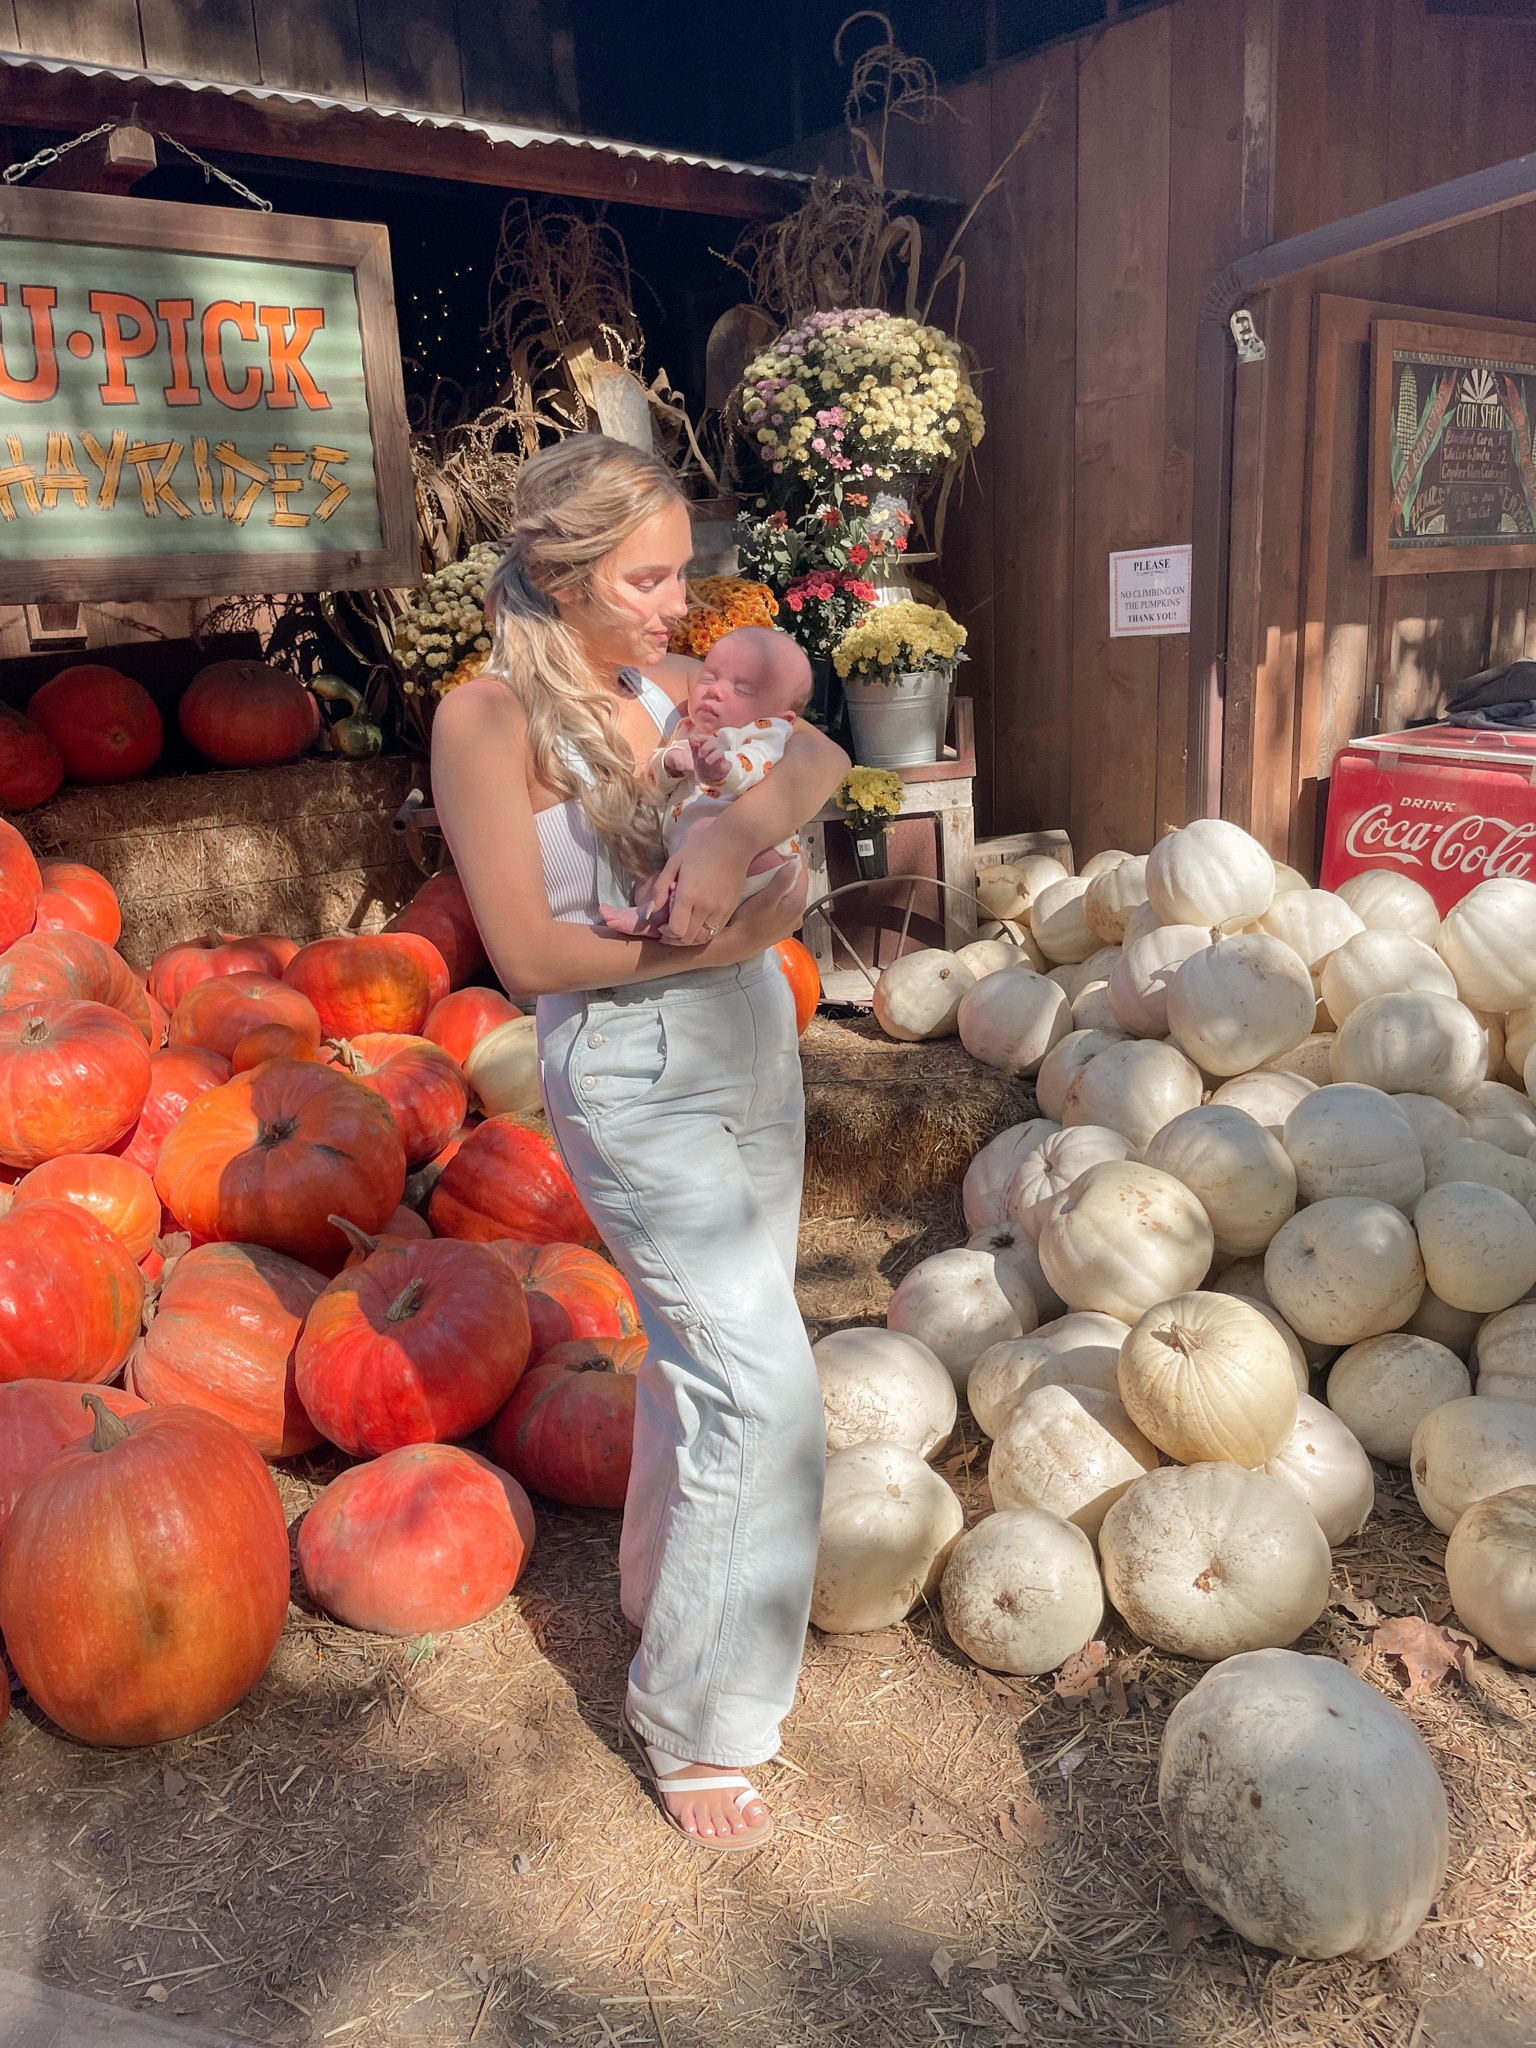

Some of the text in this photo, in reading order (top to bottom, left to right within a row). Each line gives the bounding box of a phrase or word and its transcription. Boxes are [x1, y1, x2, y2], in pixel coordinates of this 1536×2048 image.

[1456, 403, 1478, 428] CORN
[1476, 432, 1494, 447] Corn
[0, 429, 351, 527] HAYRIDES
[1133, 558, 1171, 572] PLEASE
[1120, 585, 1185, 599] NO CLIMBING ON
[1124, 598, 1181, 610] THE PUMPKINS
[1128, 611, 1177, 623] THANK YOU!
[1400, 796, 1457, 813] DRINK
[1345, 803, 1536, 879] Coca-Cola
